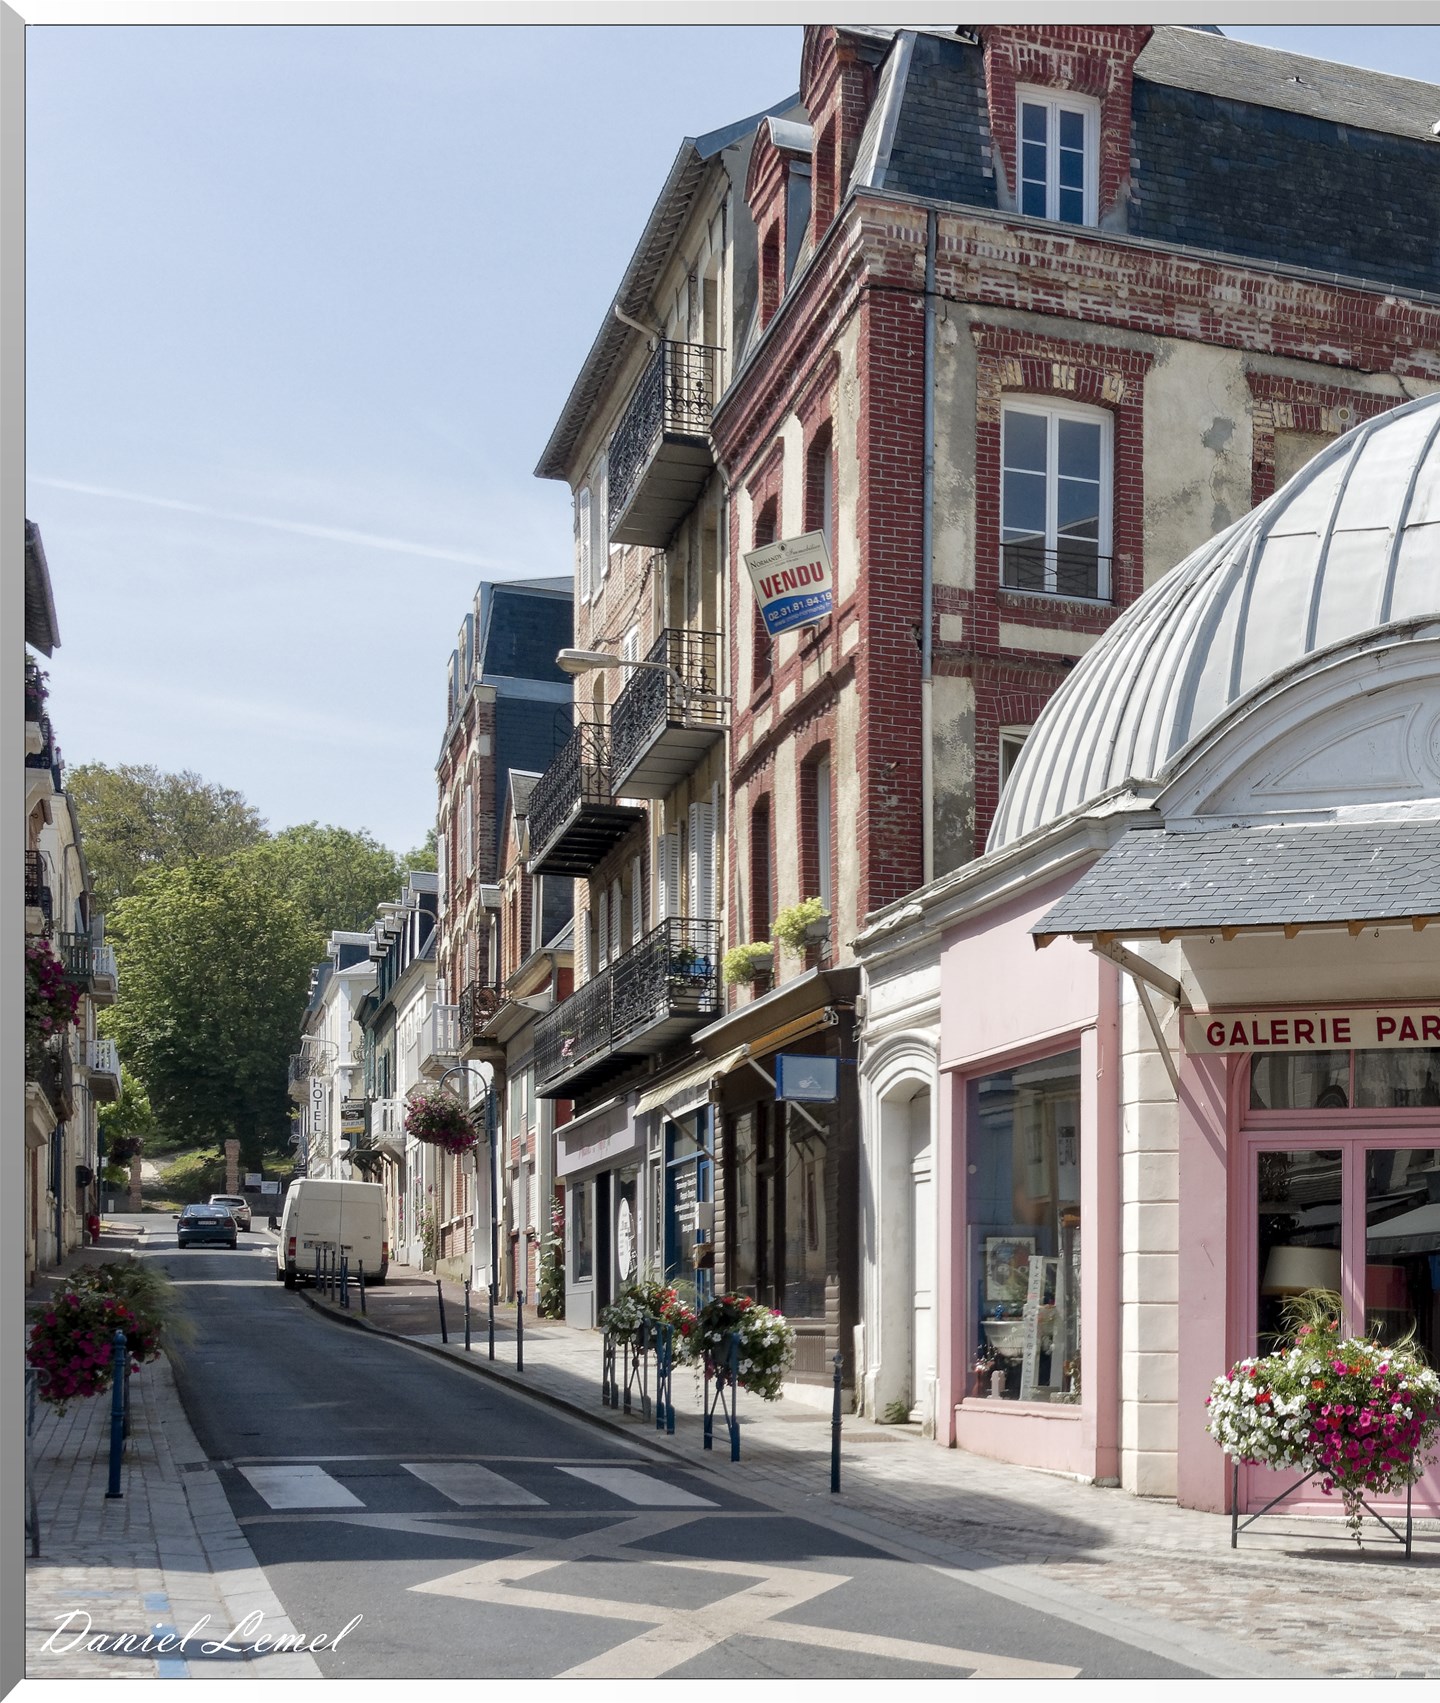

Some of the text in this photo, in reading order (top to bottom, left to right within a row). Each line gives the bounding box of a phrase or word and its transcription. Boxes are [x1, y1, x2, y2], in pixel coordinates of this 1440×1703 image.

[750, 554, 782, 569] NORMANDY
[759, 561, 824, 599] VENDU
[768, 592, 832, 621] 02.31.81.94.19
[1206, 1017, 1352, 1046] GALERIE
[313, 1078, 323, 1132] HOTEL
